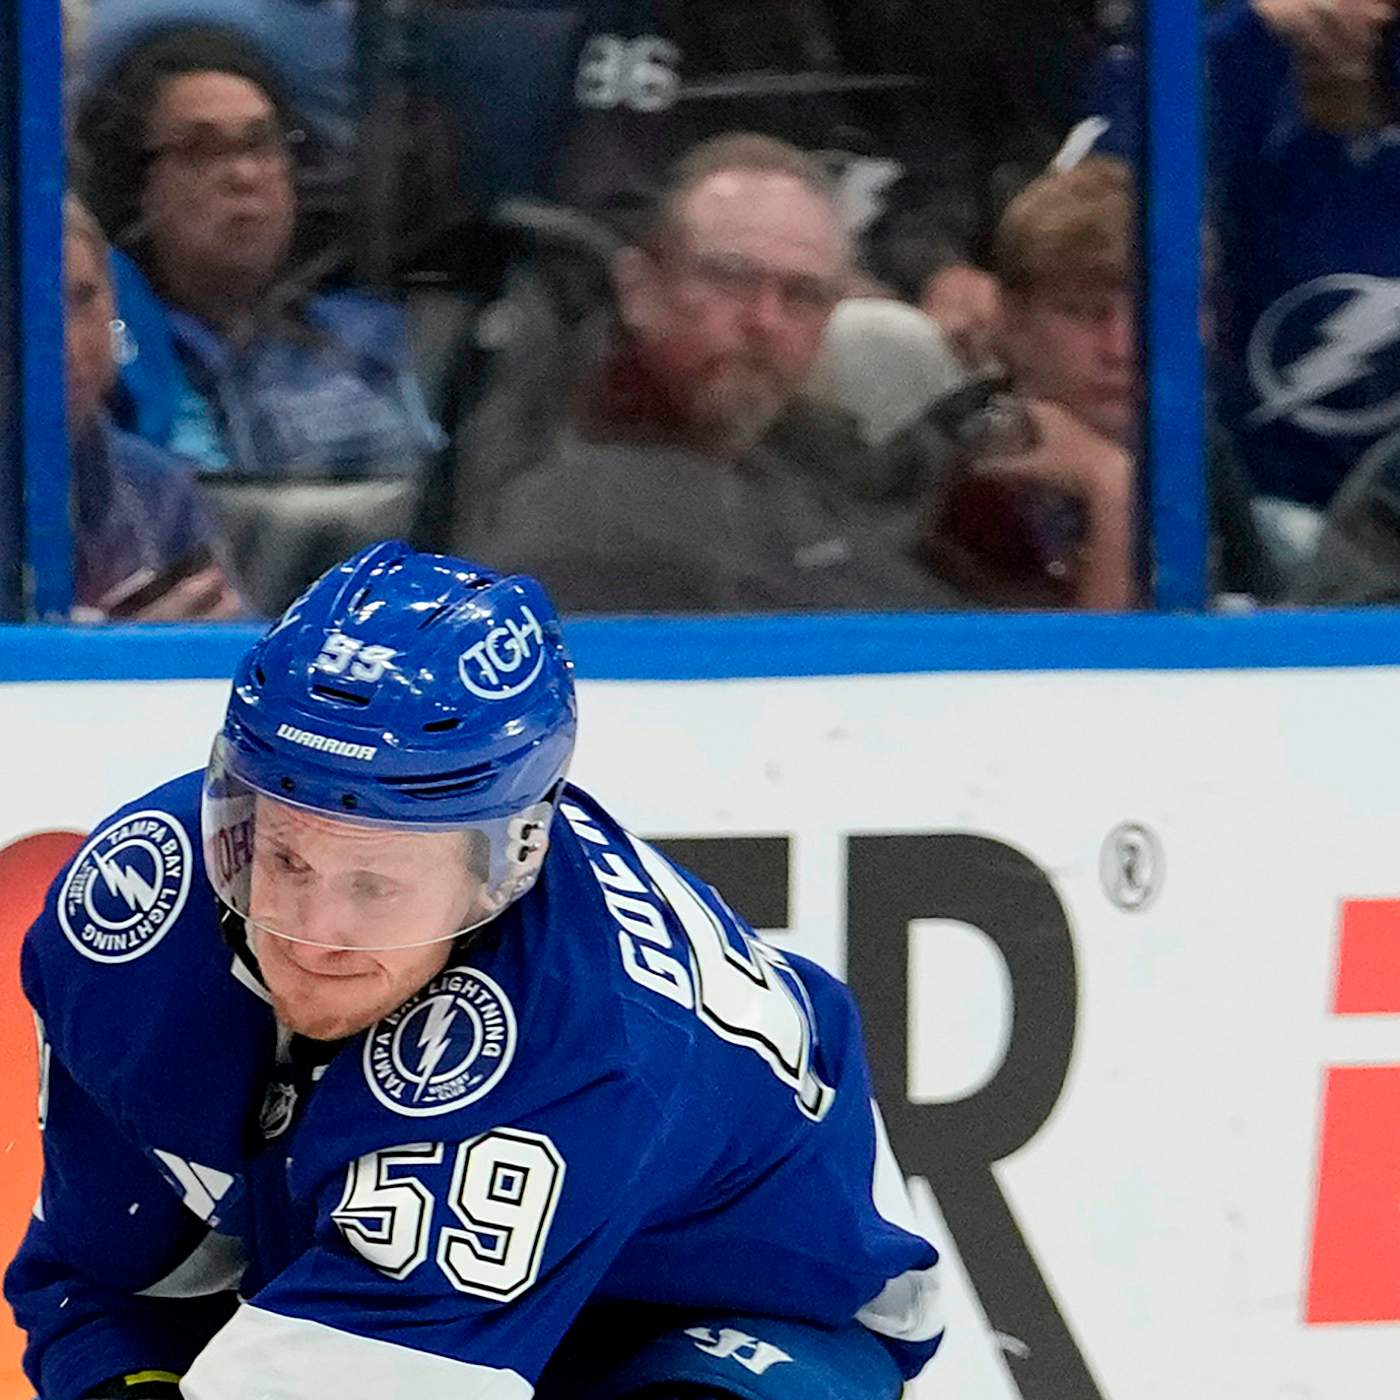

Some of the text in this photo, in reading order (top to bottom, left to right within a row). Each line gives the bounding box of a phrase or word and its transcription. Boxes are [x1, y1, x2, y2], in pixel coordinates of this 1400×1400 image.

[461, 604, 545, 687] TGH
[276, 723, 378, 762] WARRIOR
[107, 820, 168, 846] TAMPA
[160, 838, 182, 878] BAY
[81, 887, 178, 951] LIGHTNING
[330, 1127, 567, 1303] 59
